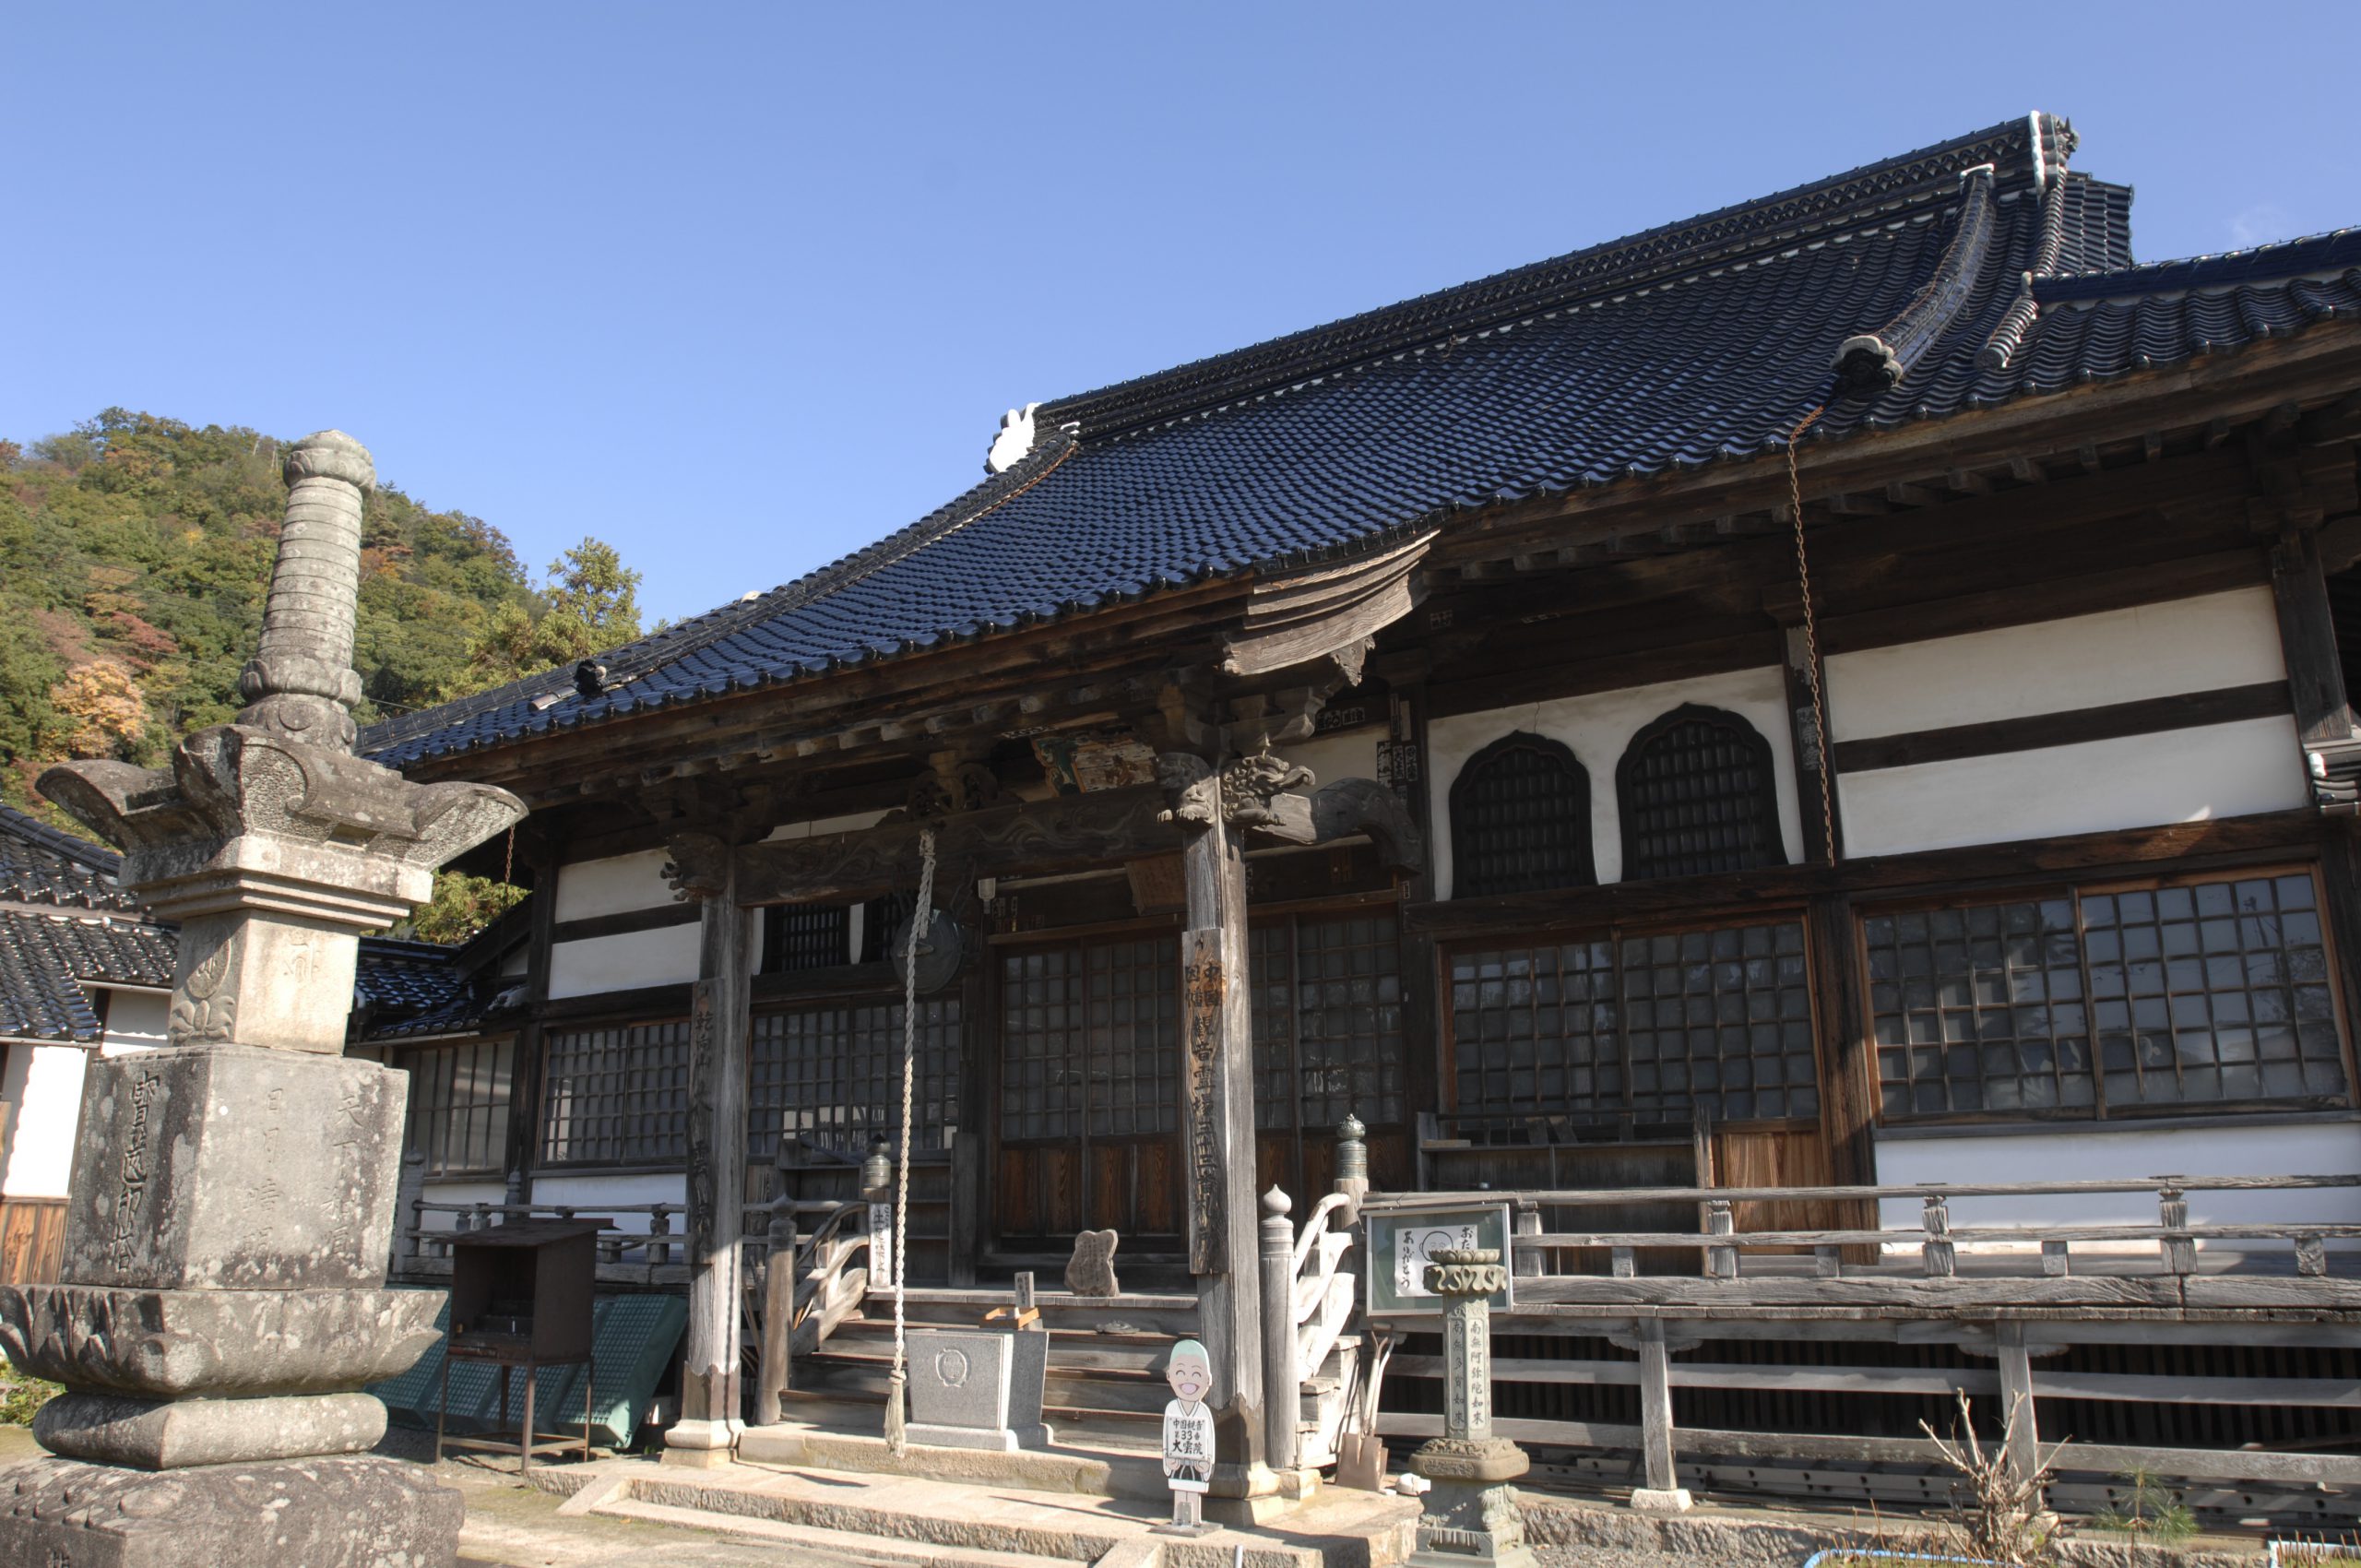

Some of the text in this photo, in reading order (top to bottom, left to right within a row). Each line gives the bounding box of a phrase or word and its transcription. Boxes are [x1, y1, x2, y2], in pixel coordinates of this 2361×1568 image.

[1401, 1230, 1415, 1289] ありがとう
[1172, 1418, 1203, 1431] 中国観音
[1172, 1439, 1203, 1455] 大雲院
